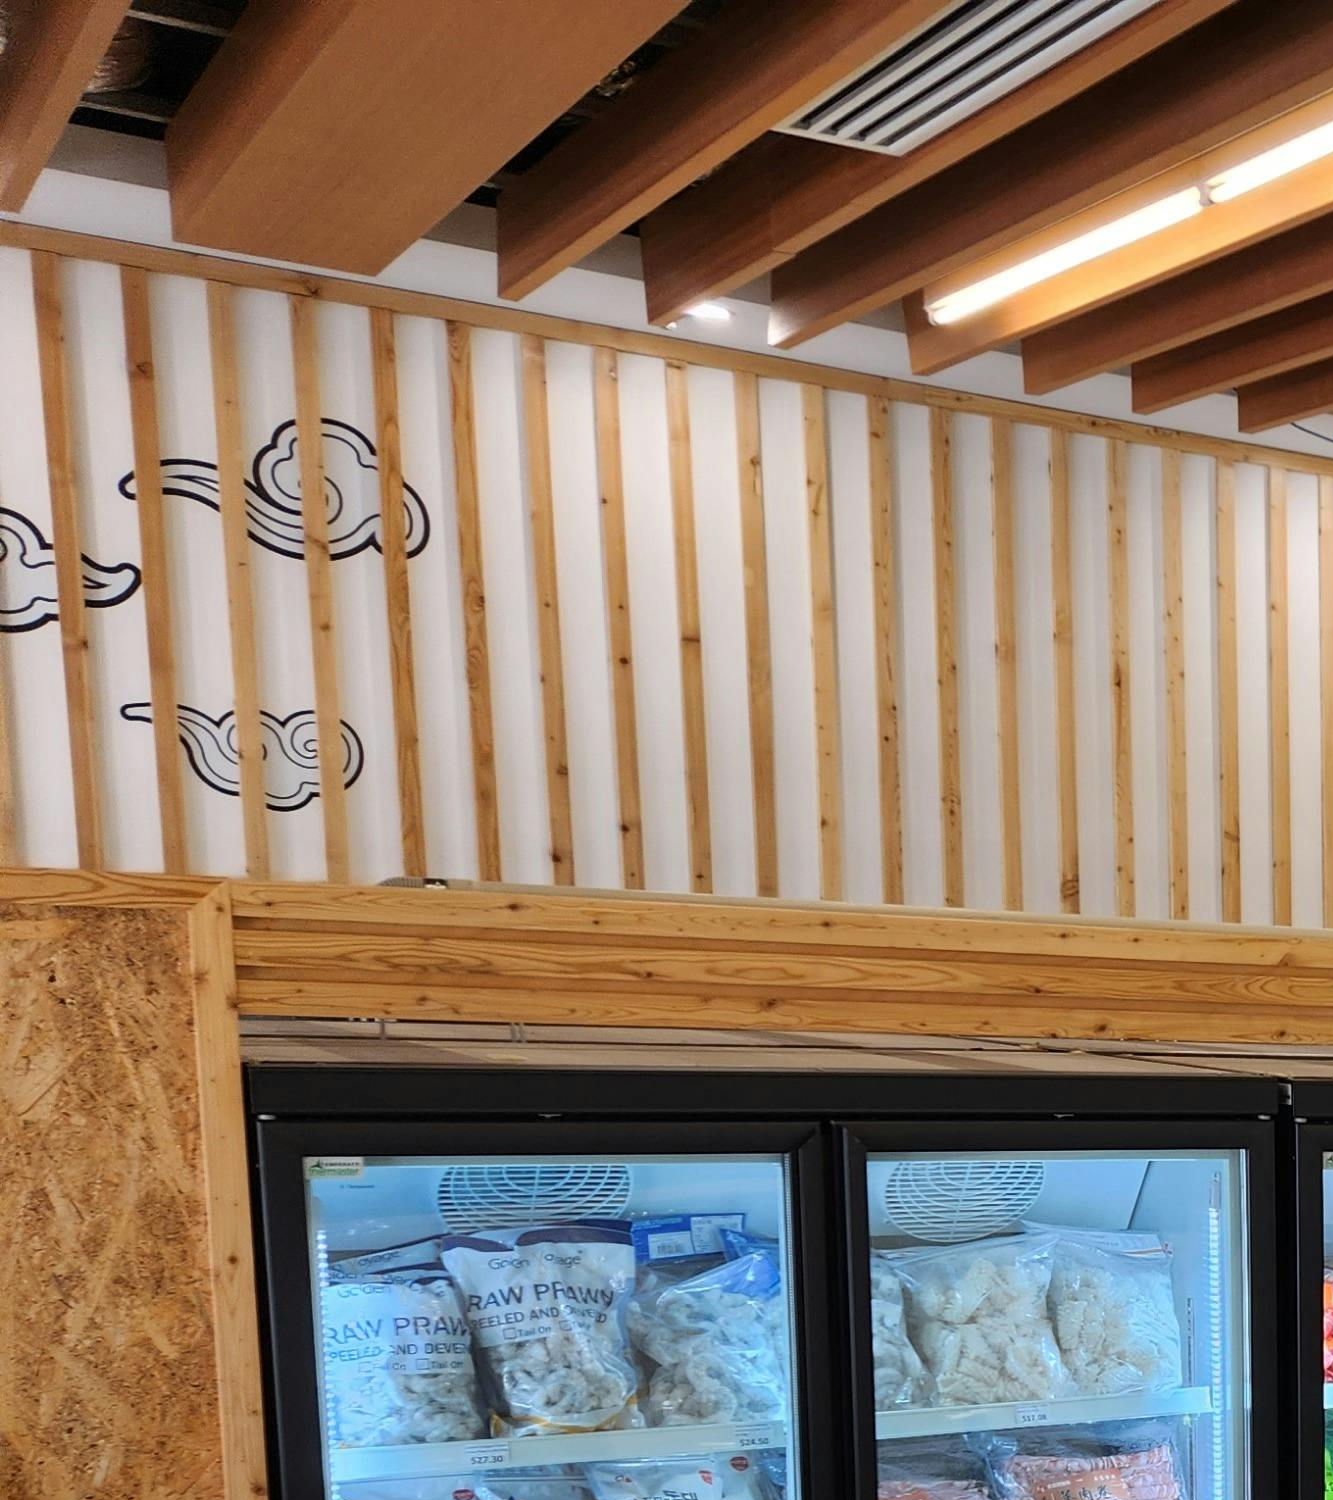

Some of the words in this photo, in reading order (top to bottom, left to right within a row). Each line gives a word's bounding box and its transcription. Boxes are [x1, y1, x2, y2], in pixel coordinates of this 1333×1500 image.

[467, 1285, 524, 1313] RAW
[471, 1311, 525, 1329] PEELED
[529, 1306, 560, 1321] AND
[326, 1318, 382, 1346] RAW
